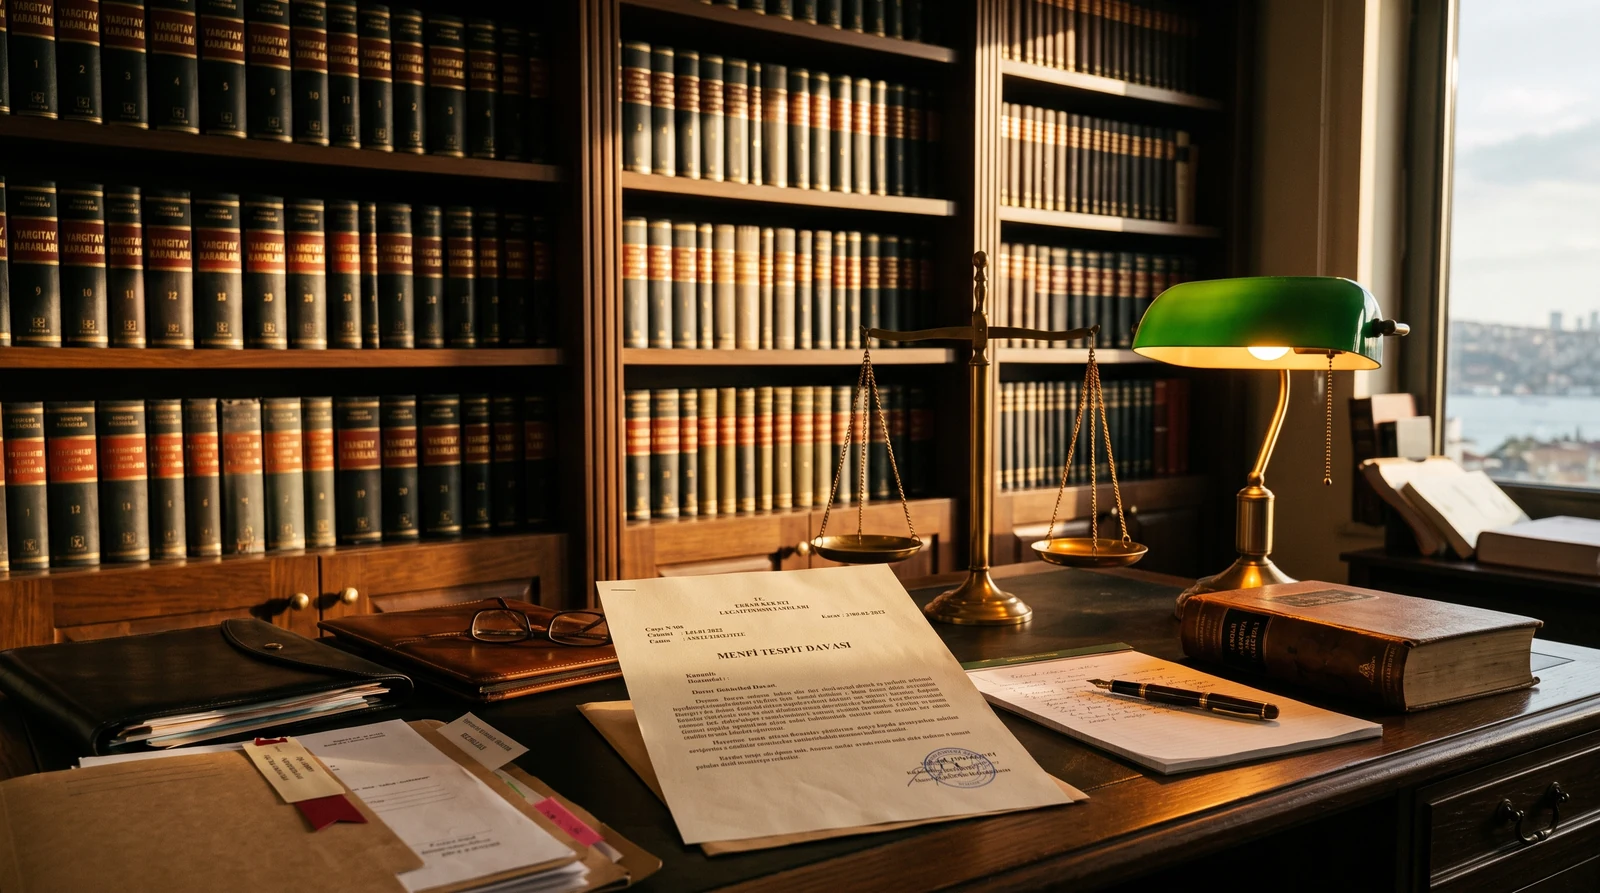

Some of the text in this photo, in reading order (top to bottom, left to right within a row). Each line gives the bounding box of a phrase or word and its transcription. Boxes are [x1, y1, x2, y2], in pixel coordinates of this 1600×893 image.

[13, 1, 52, 14] YARGITAY
[12, 13, 53, 27] KARARLARI
[60, 8, 98, 21] YARGITAY
[59, 20, 98, 33] KARARLARI
[105, 15, 144, 28] YARGITAY
[155, 21, 194, 34] YARGITAY
[104, 27, 145, 40] KARARLARI
[153, 32, 195, 46] KARARLARI
[205, 27, 242, 41] YARGITAY
[203, 39, 244, 53] KARARLARI
[252, 34, 288, 48] YARGITAY
[33, 59, 39, 69] 1
[79, 64, 86, 74] 2
[124, 71, 132, 81] 3
[173, 76, 181, 86] 4
[222, 81, 229, 91] 5
[308, 90, 320, 101] 10
[16, 229, 56, 241] YARGITAY
[66, 233, 104, 244] YARGITAY
[14, 241, 58, 253] KARARLARI
[151, 238, 189, 248] YARGITAY
[201, 240, 238, 251] YARGITAY
[64, 244, 105, 256] KARARLARI
[150, 250, 191, 260] KARARLARI
[35, 286, 41, 297] 9
[82, 288, 92, 298] 10
[125, 289, 134, 299] 11
[168, 291, 178, 300] 12
[70, 504, 81, 515] 12
[717, 641, 852, 660] MENFİ TESPİT DAVASI
